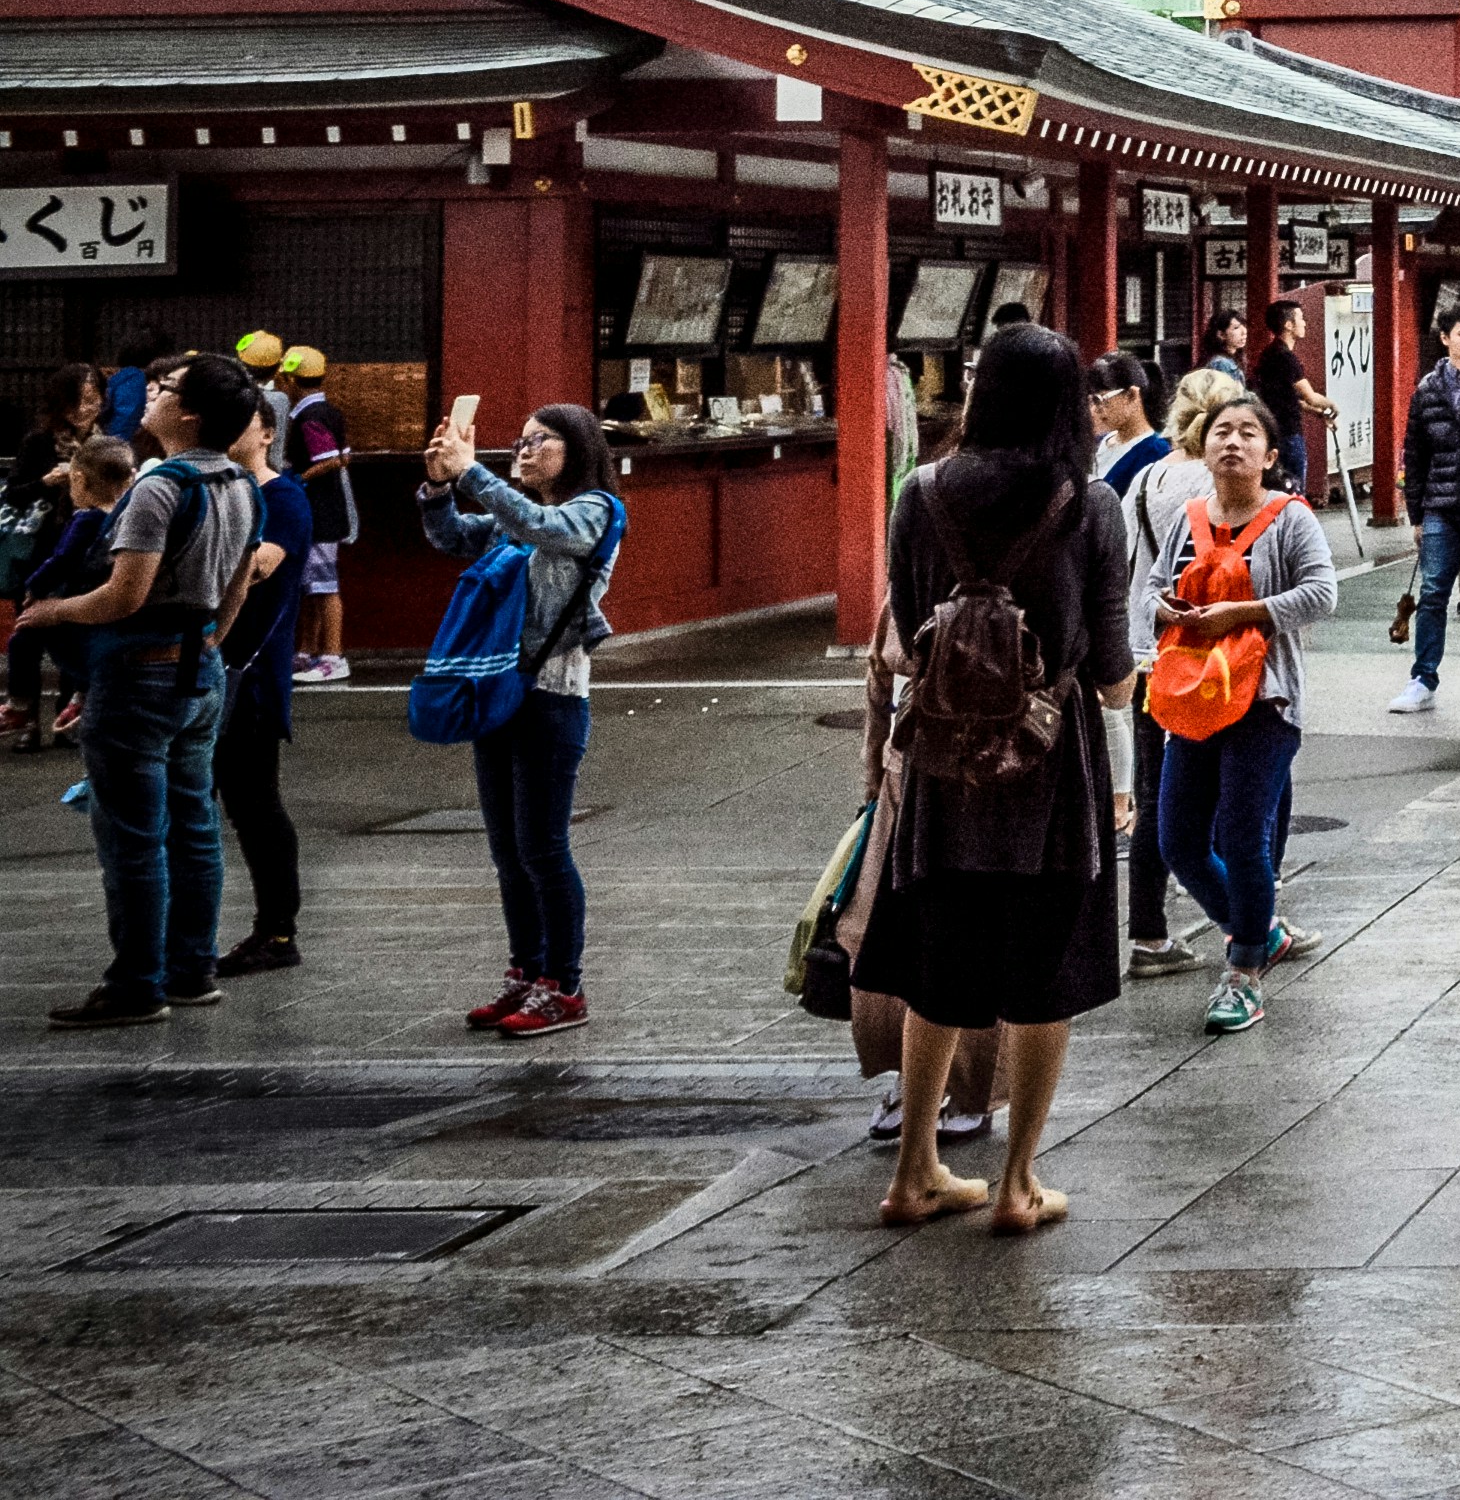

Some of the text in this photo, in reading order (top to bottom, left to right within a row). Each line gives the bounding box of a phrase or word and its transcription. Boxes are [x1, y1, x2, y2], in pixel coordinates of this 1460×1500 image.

[0, 195, 148, 253] くじ
[1331, 326, 1370, 378] みくじ
